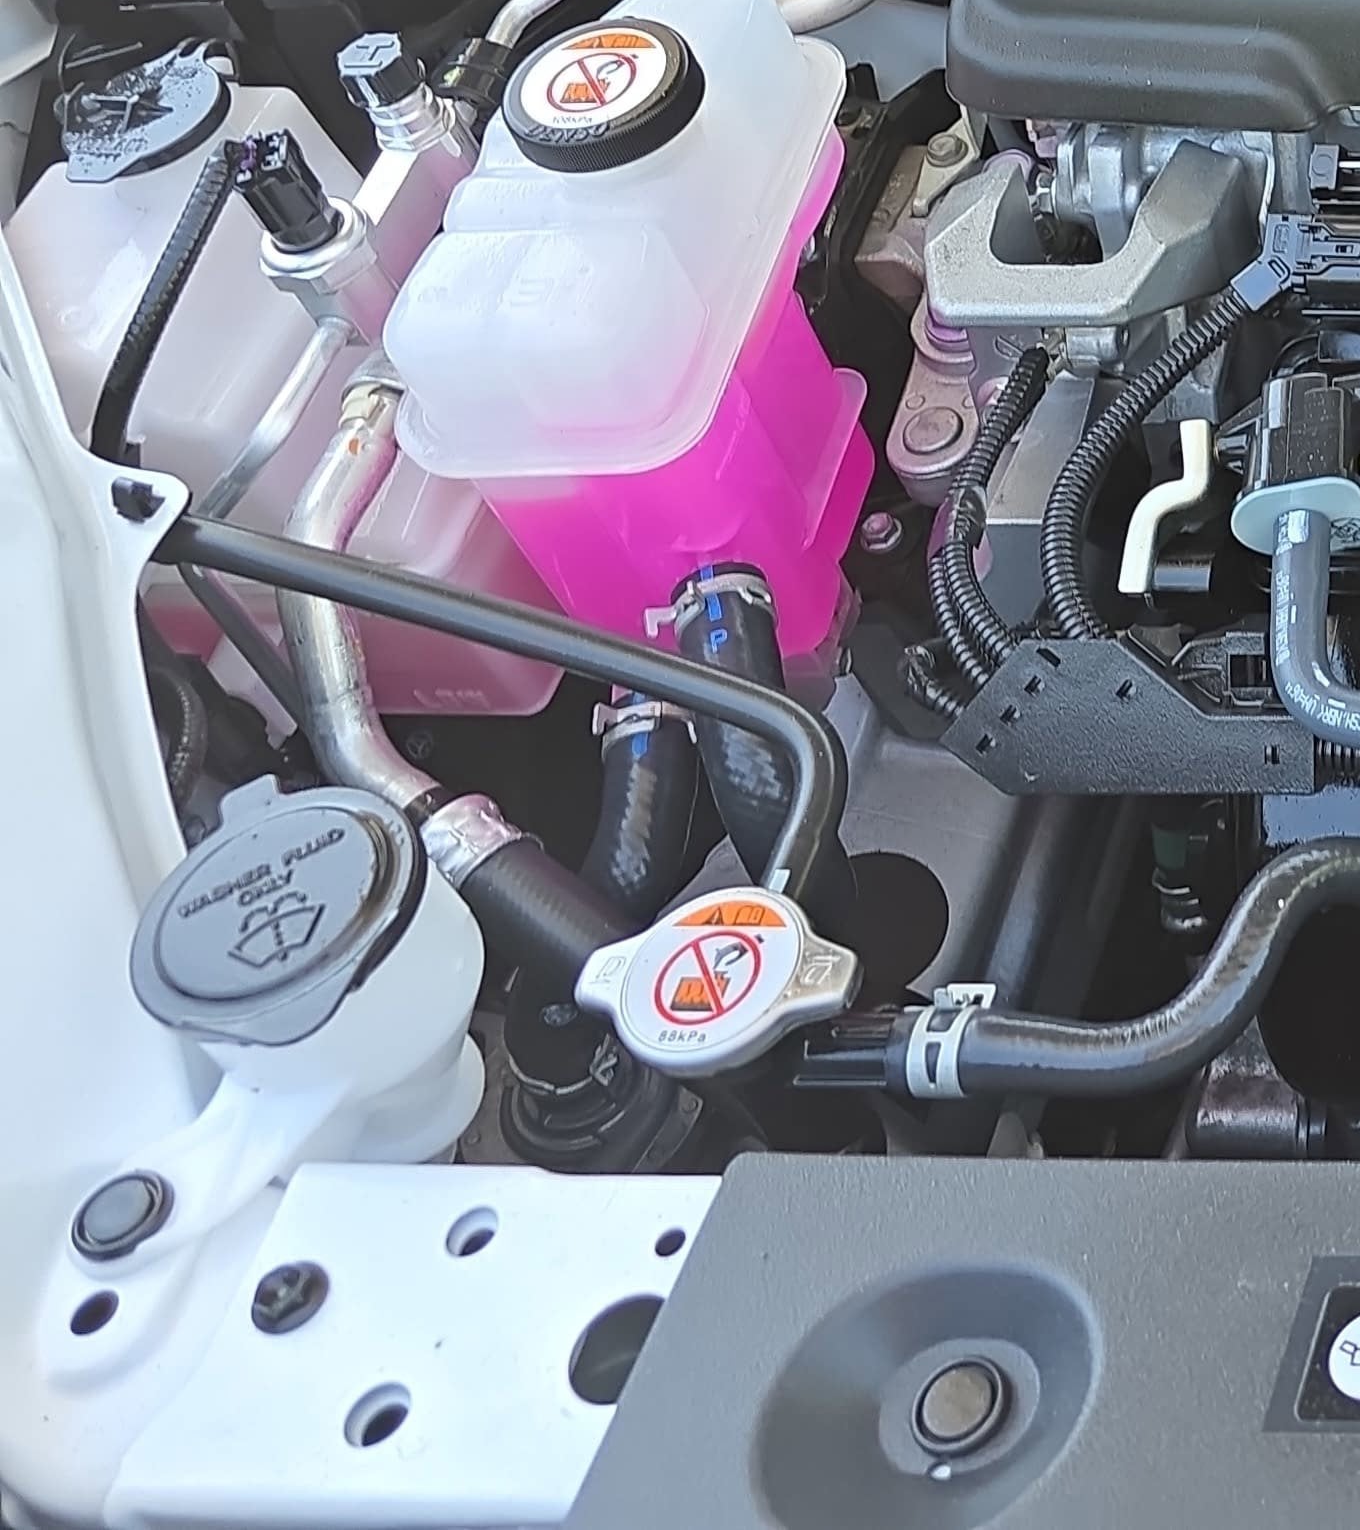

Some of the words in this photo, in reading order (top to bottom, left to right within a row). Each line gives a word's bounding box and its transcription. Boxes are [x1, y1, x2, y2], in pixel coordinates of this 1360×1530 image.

[177, 864, 272, 918] WASHER
[281, 828, 345, 866] FLUID
[238, 869, 294, 907] ONLY
[658, 1028, 707, 1044] 88kPa
